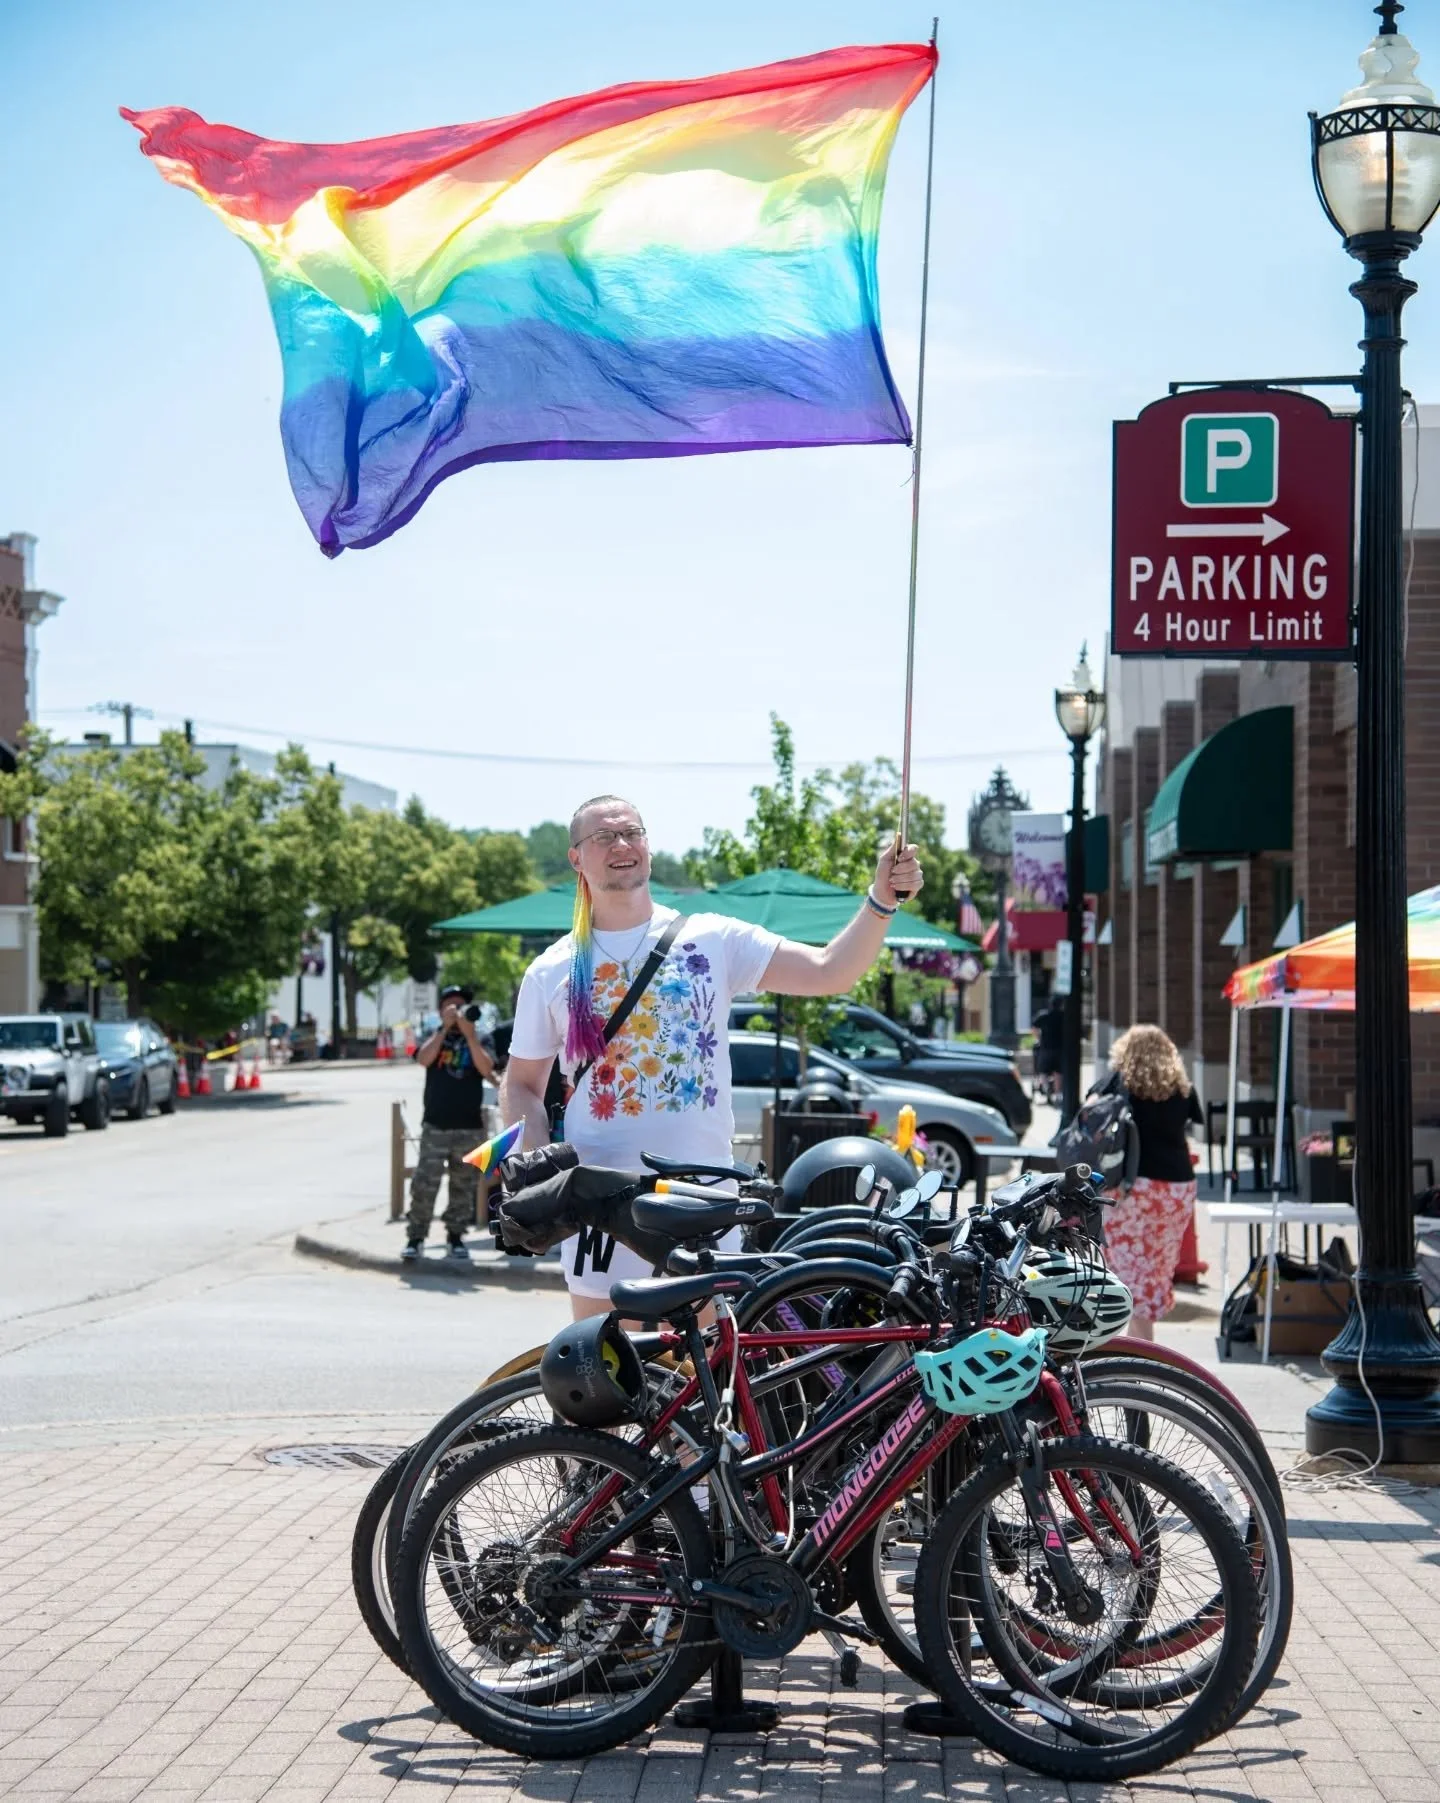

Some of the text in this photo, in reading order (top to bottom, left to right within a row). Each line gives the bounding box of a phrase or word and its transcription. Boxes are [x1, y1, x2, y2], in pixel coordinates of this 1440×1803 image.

[1206, 428, 1252, 493] P
[1130, 554, 1328, 601] PARKING
[1133, 610, 1323, 642] 4 Hour Limit
[811, 1392, 927, 1548] MONGOOSE
